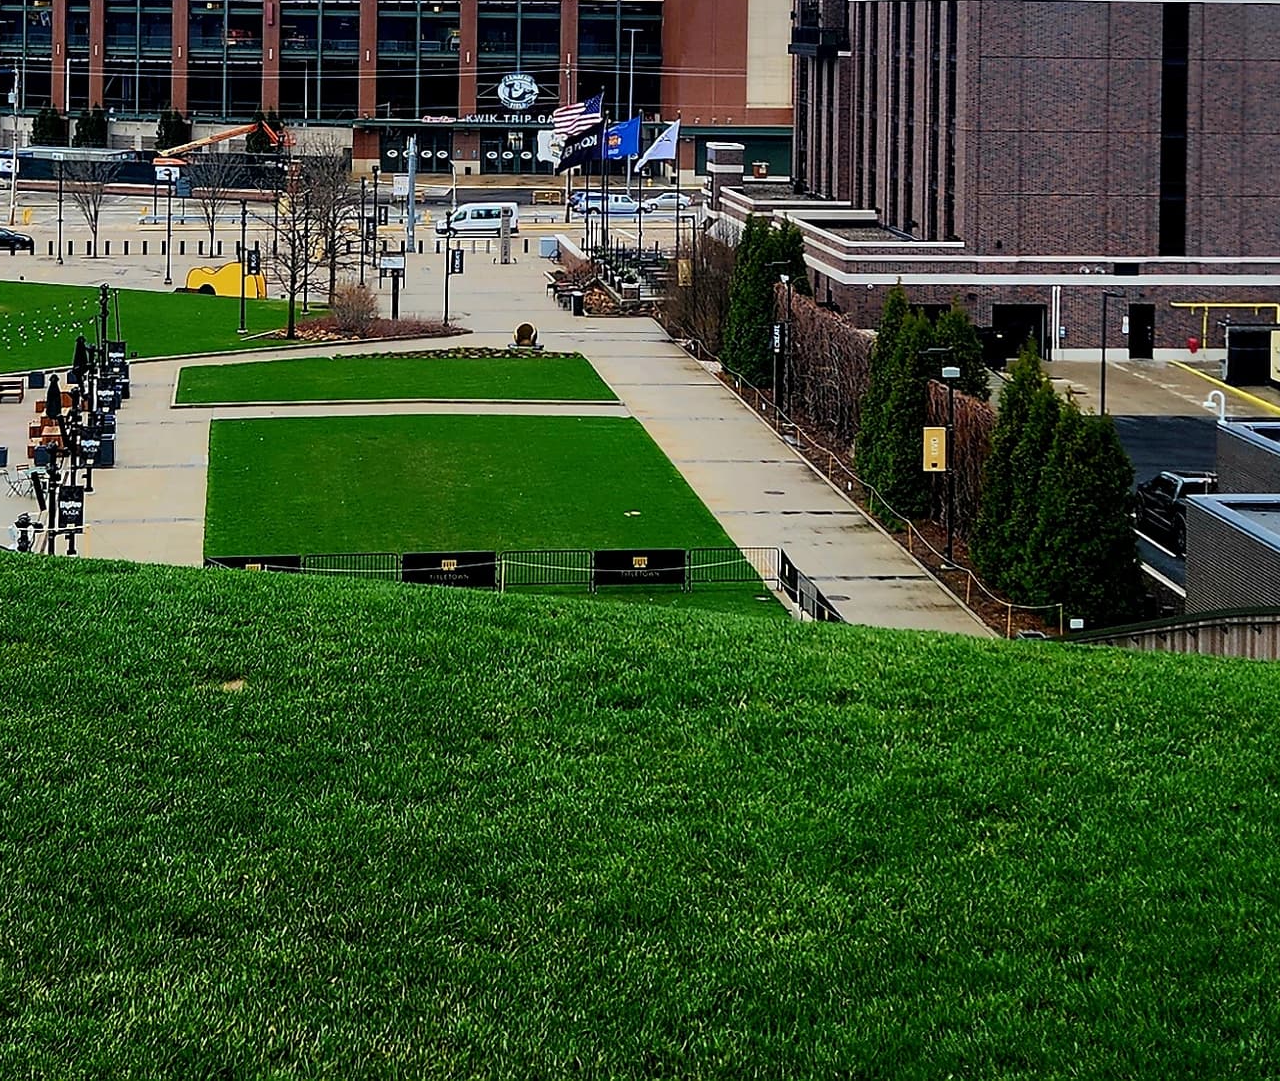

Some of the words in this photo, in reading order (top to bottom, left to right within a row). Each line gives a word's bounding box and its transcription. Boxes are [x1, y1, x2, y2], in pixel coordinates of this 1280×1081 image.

[465, 114, 498, 124] KWIK
[504, 114, 532, 124] TRIP
[538, 114, 555, 124] GA
